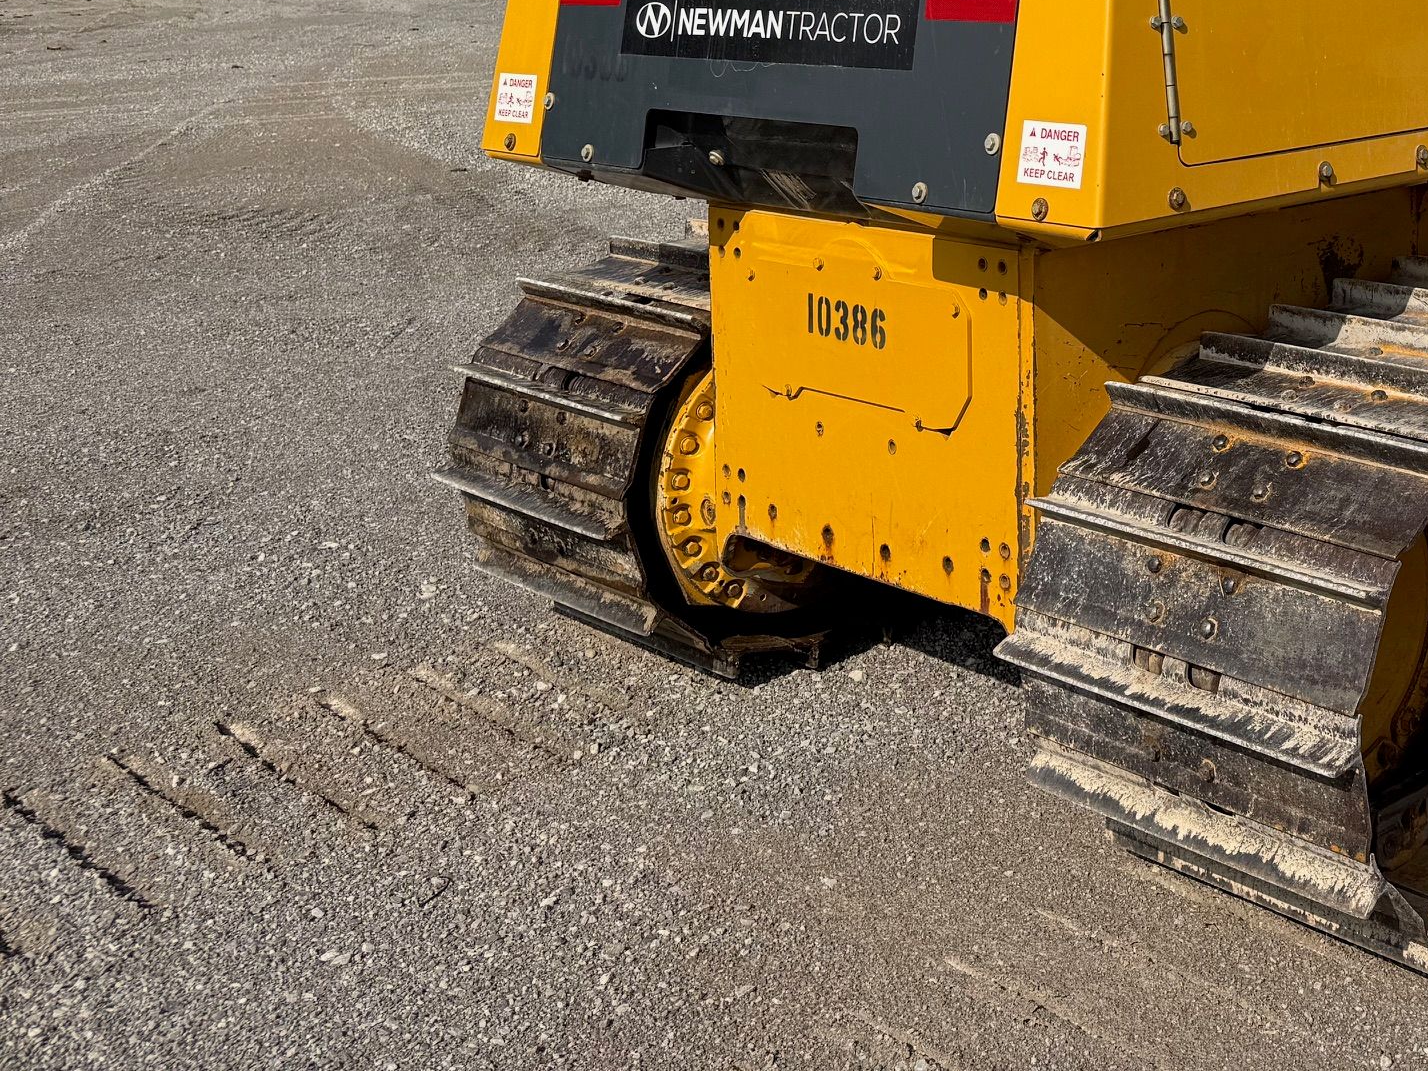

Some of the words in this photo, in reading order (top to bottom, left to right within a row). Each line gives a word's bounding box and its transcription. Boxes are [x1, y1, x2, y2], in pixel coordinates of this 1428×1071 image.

[509, 78, 533, 88] DANGER
[498, 109, 511, 117] KEEP
[512, 109, 529, 119] CLEAR
[1040, 128, 1080, 142] DANGER
[1023, 167, 1046, 179] KEEP
[1046, 170, 1075, 182] CLEAR
[807, 292, 886, 350] 10386
